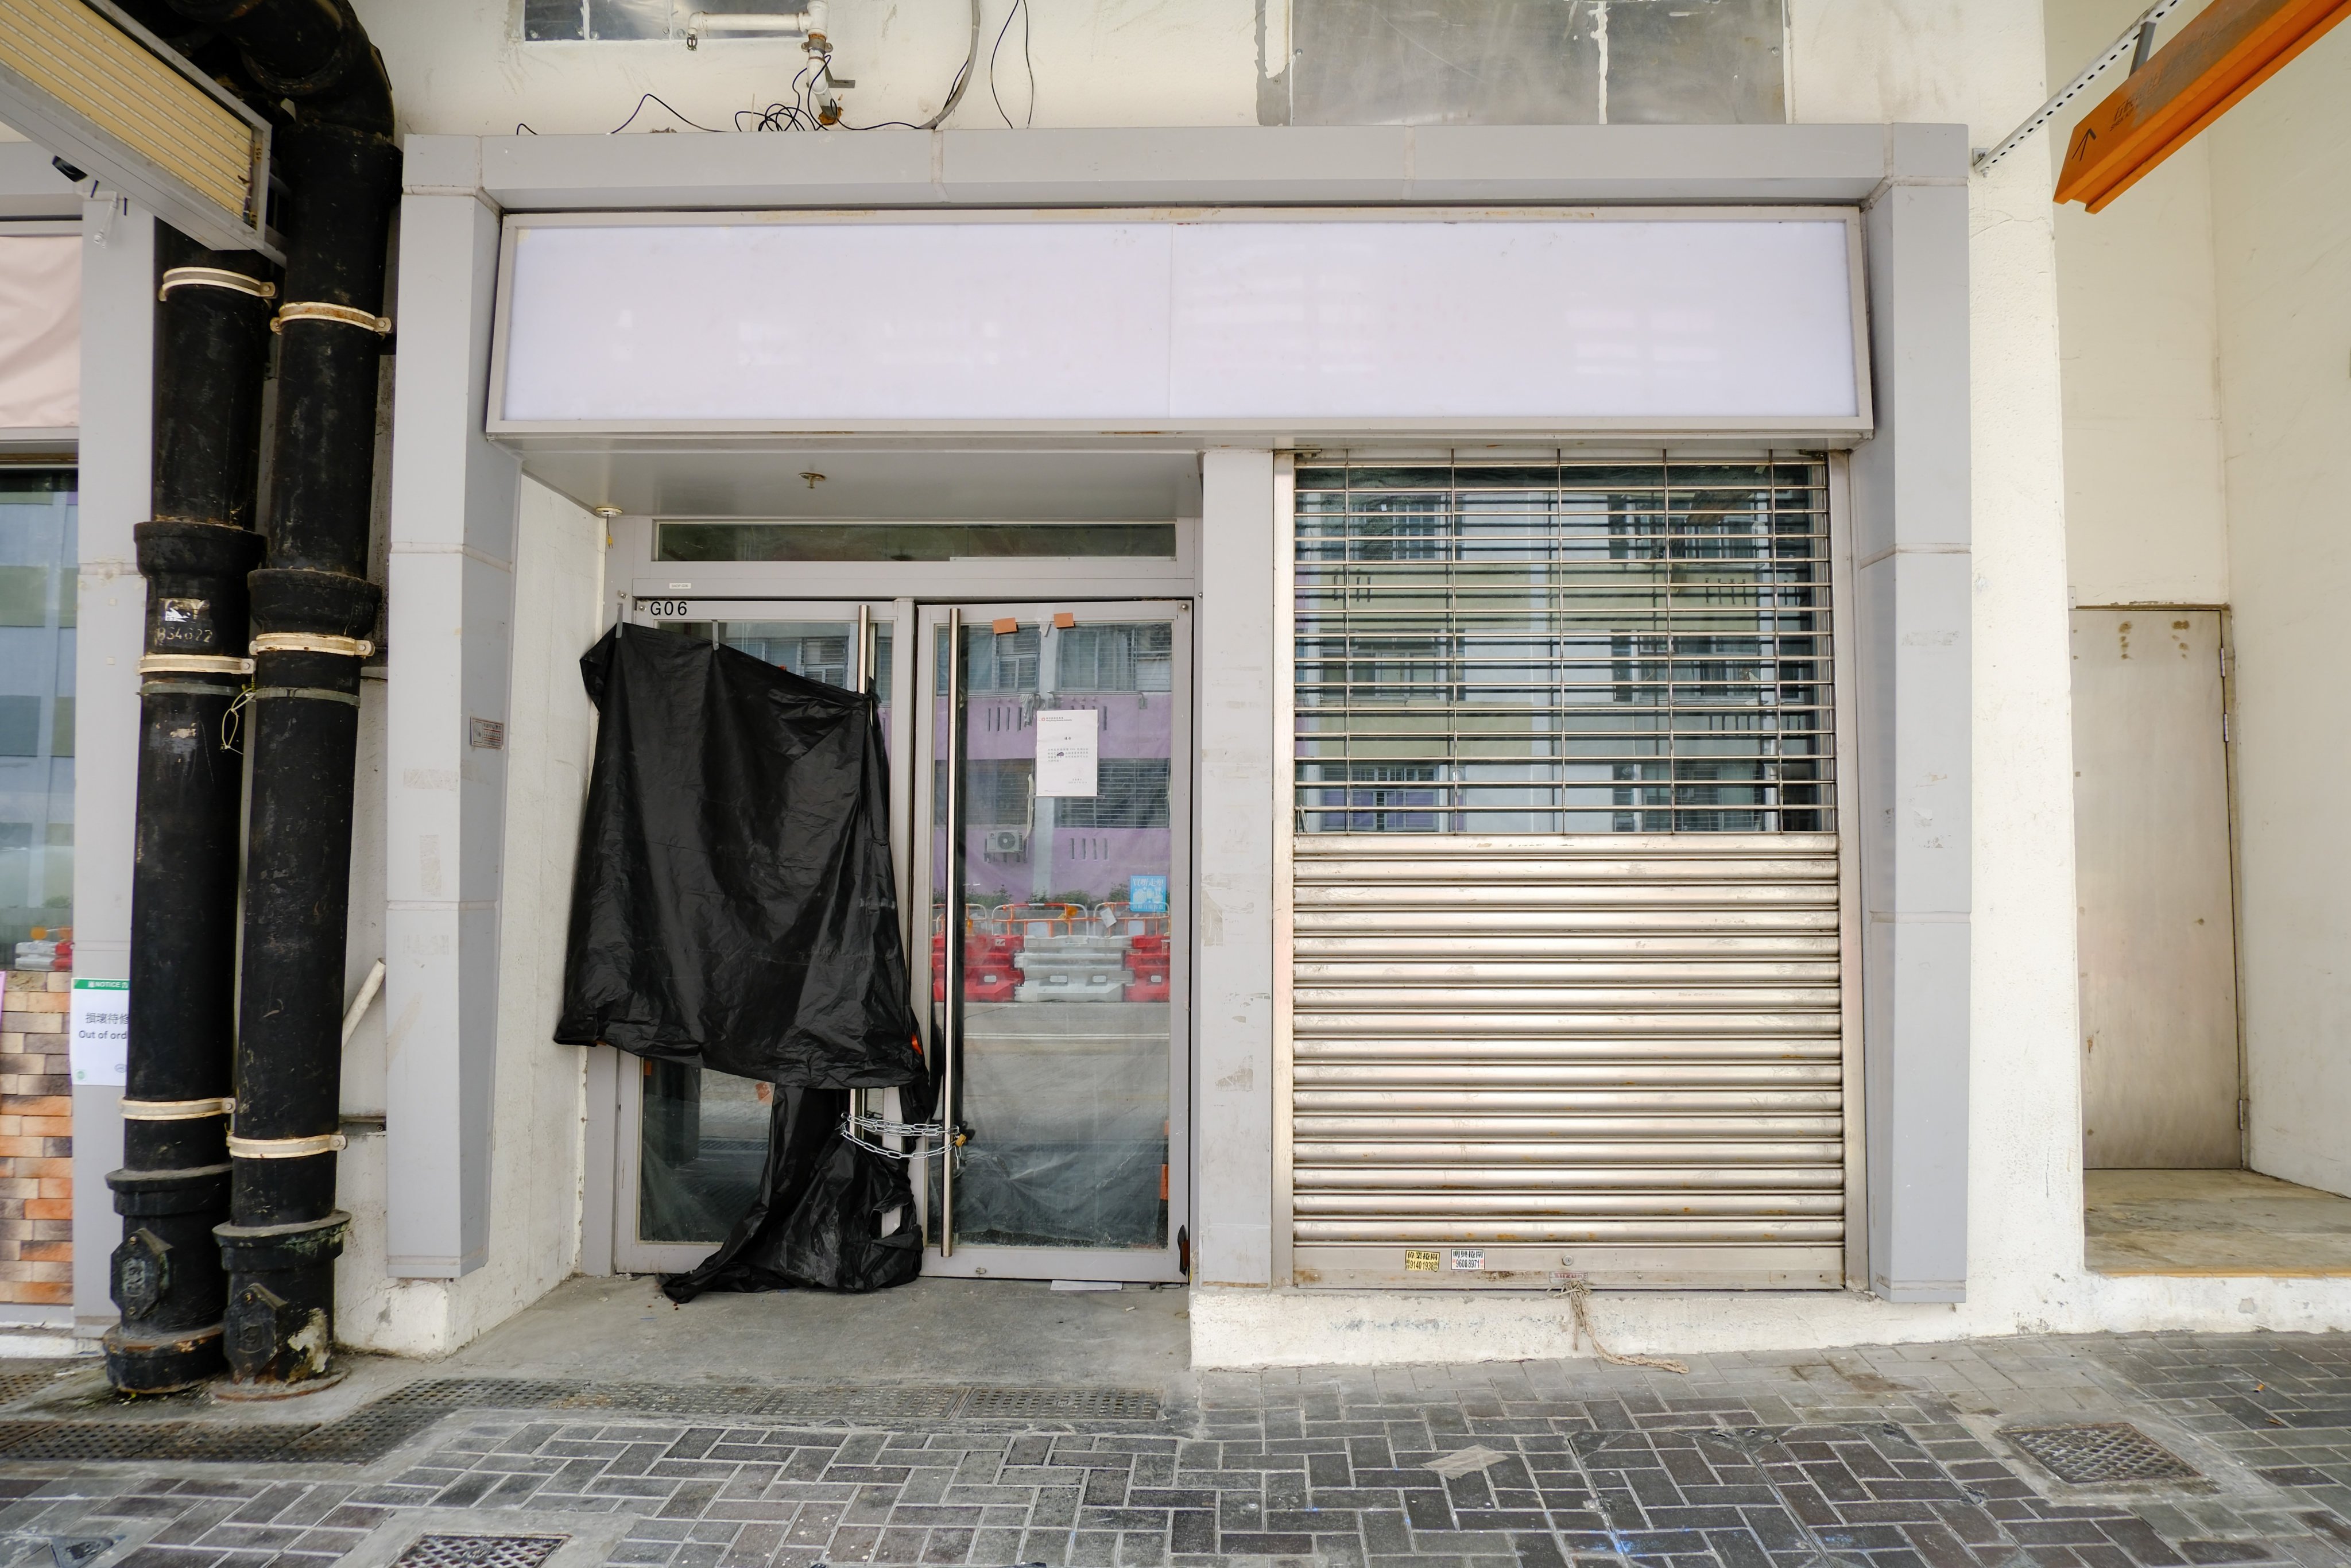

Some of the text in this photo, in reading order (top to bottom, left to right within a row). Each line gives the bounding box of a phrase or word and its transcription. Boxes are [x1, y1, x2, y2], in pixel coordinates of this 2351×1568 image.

[650, 601, 687, 615] G06
[79, 1030, 95, 1039] Out
[98, 1031, 108, 1039] of
